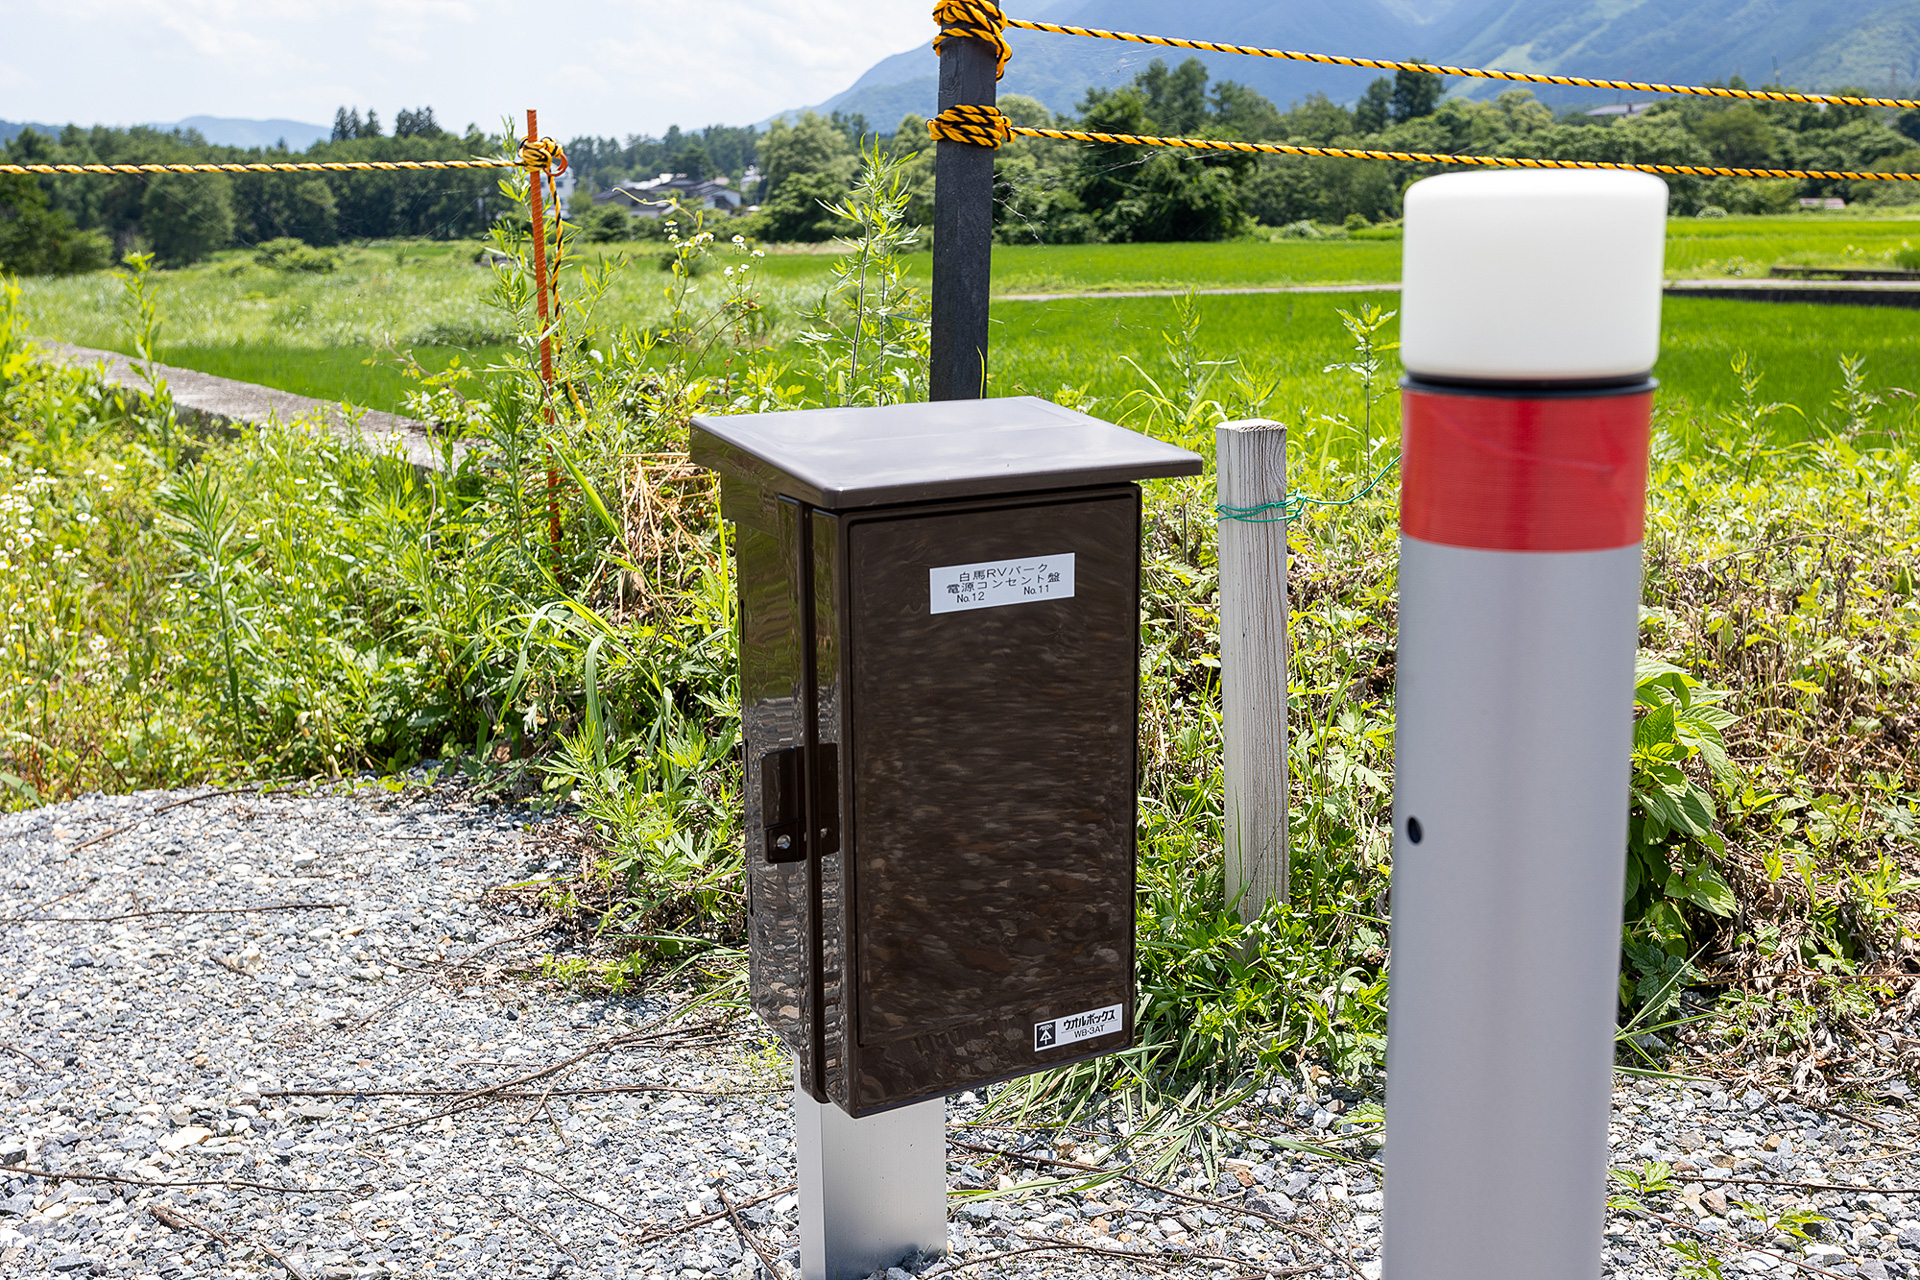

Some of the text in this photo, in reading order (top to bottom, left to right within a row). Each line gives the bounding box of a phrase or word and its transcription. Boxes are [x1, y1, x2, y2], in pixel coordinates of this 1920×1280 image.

[946, 571, 1061, 594] 電源コンセント盤
